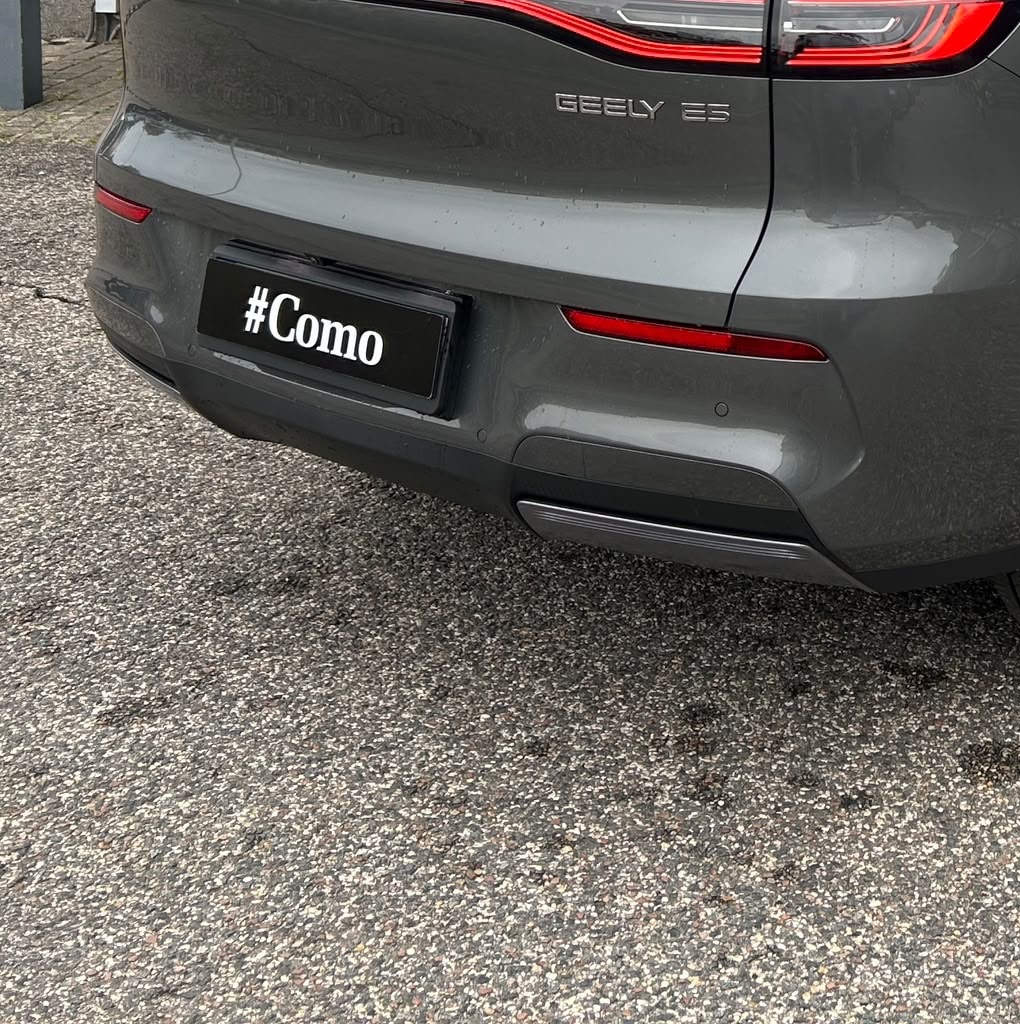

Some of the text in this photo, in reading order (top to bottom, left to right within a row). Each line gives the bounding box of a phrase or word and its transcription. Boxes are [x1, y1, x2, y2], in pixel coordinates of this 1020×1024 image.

[555, 93, 730, 122] GEELY E5
[244, 285, 384, 366] #Como
